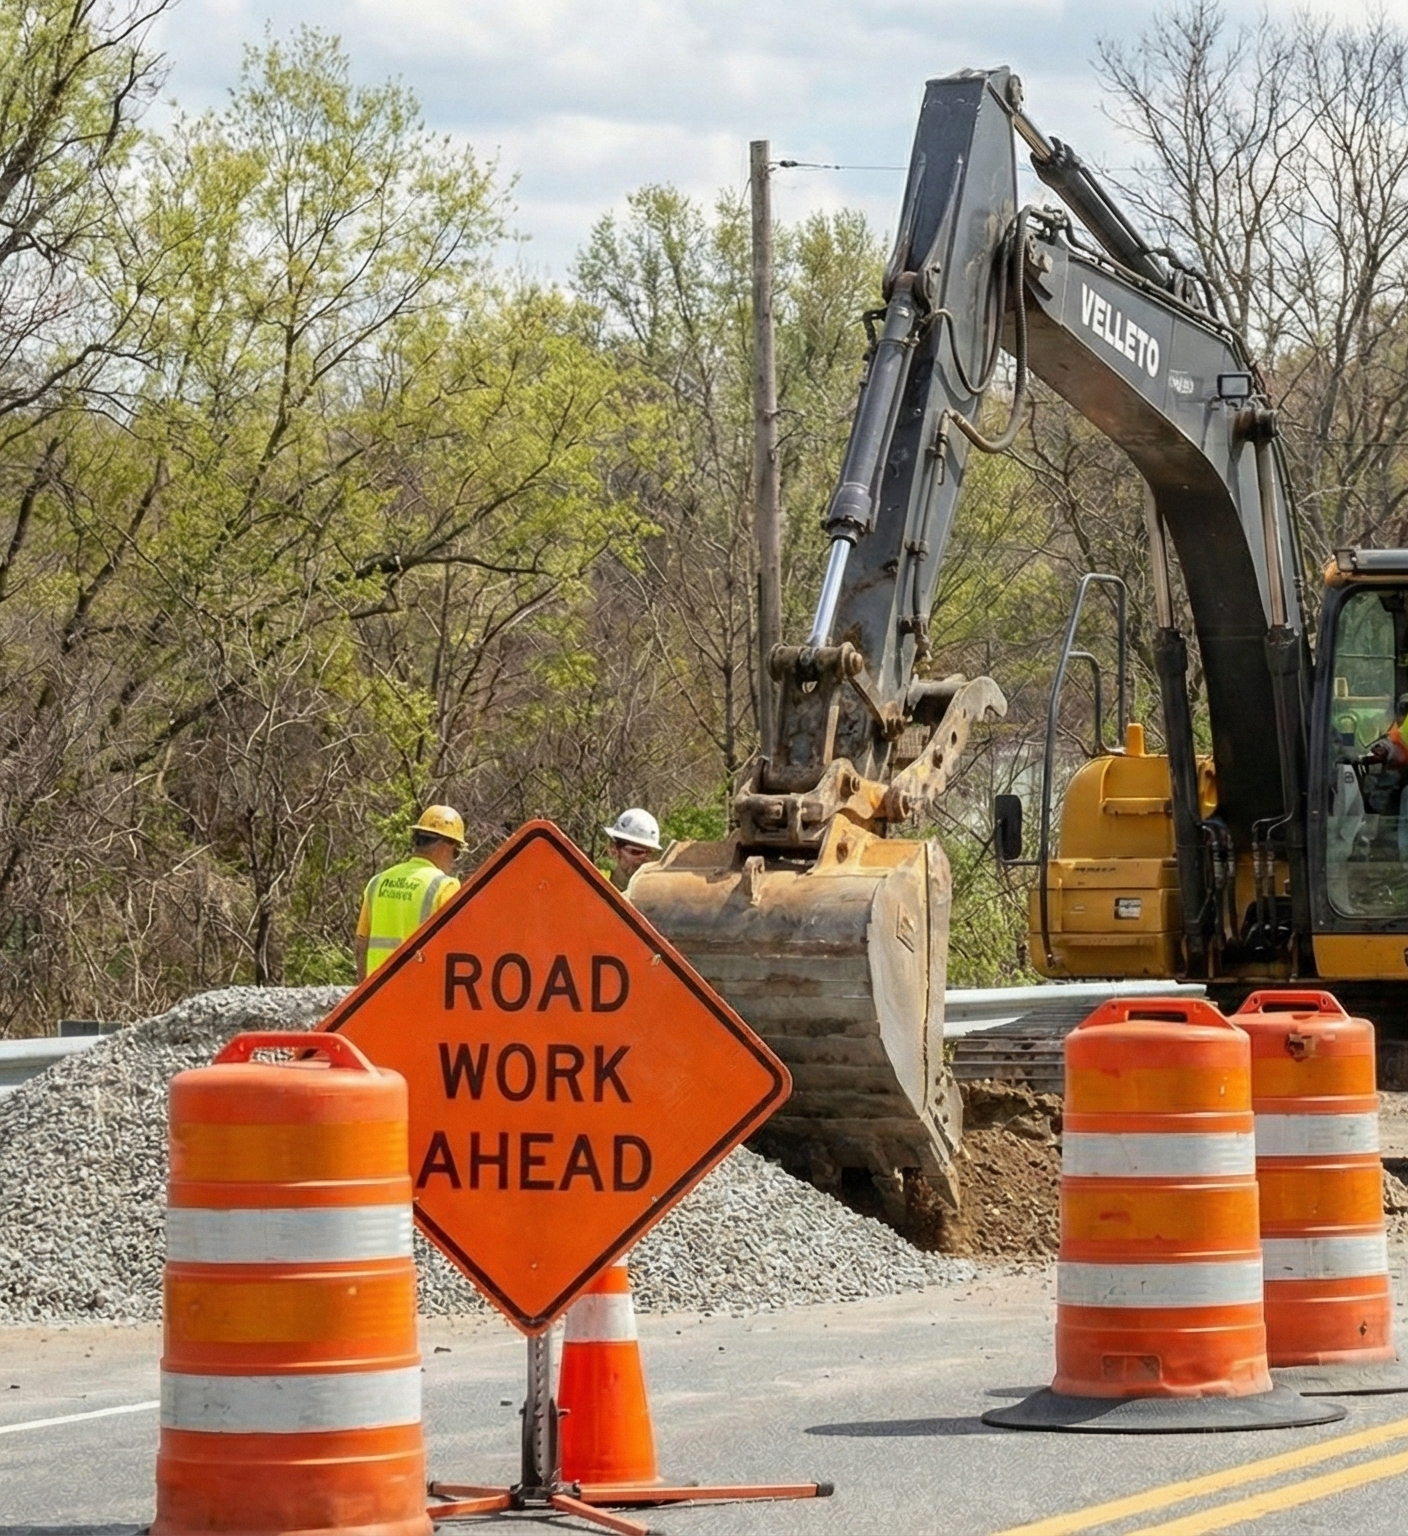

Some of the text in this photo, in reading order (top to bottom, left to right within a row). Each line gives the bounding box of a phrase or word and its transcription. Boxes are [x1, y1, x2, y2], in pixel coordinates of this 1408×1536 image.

[1081, 283, 1160, 378] VELLETO
[444, 953, 630, 1013] ROAD
[439, 1043, 632, 1103] WORK
[417, 1131, 653, 1192] AHEAD
